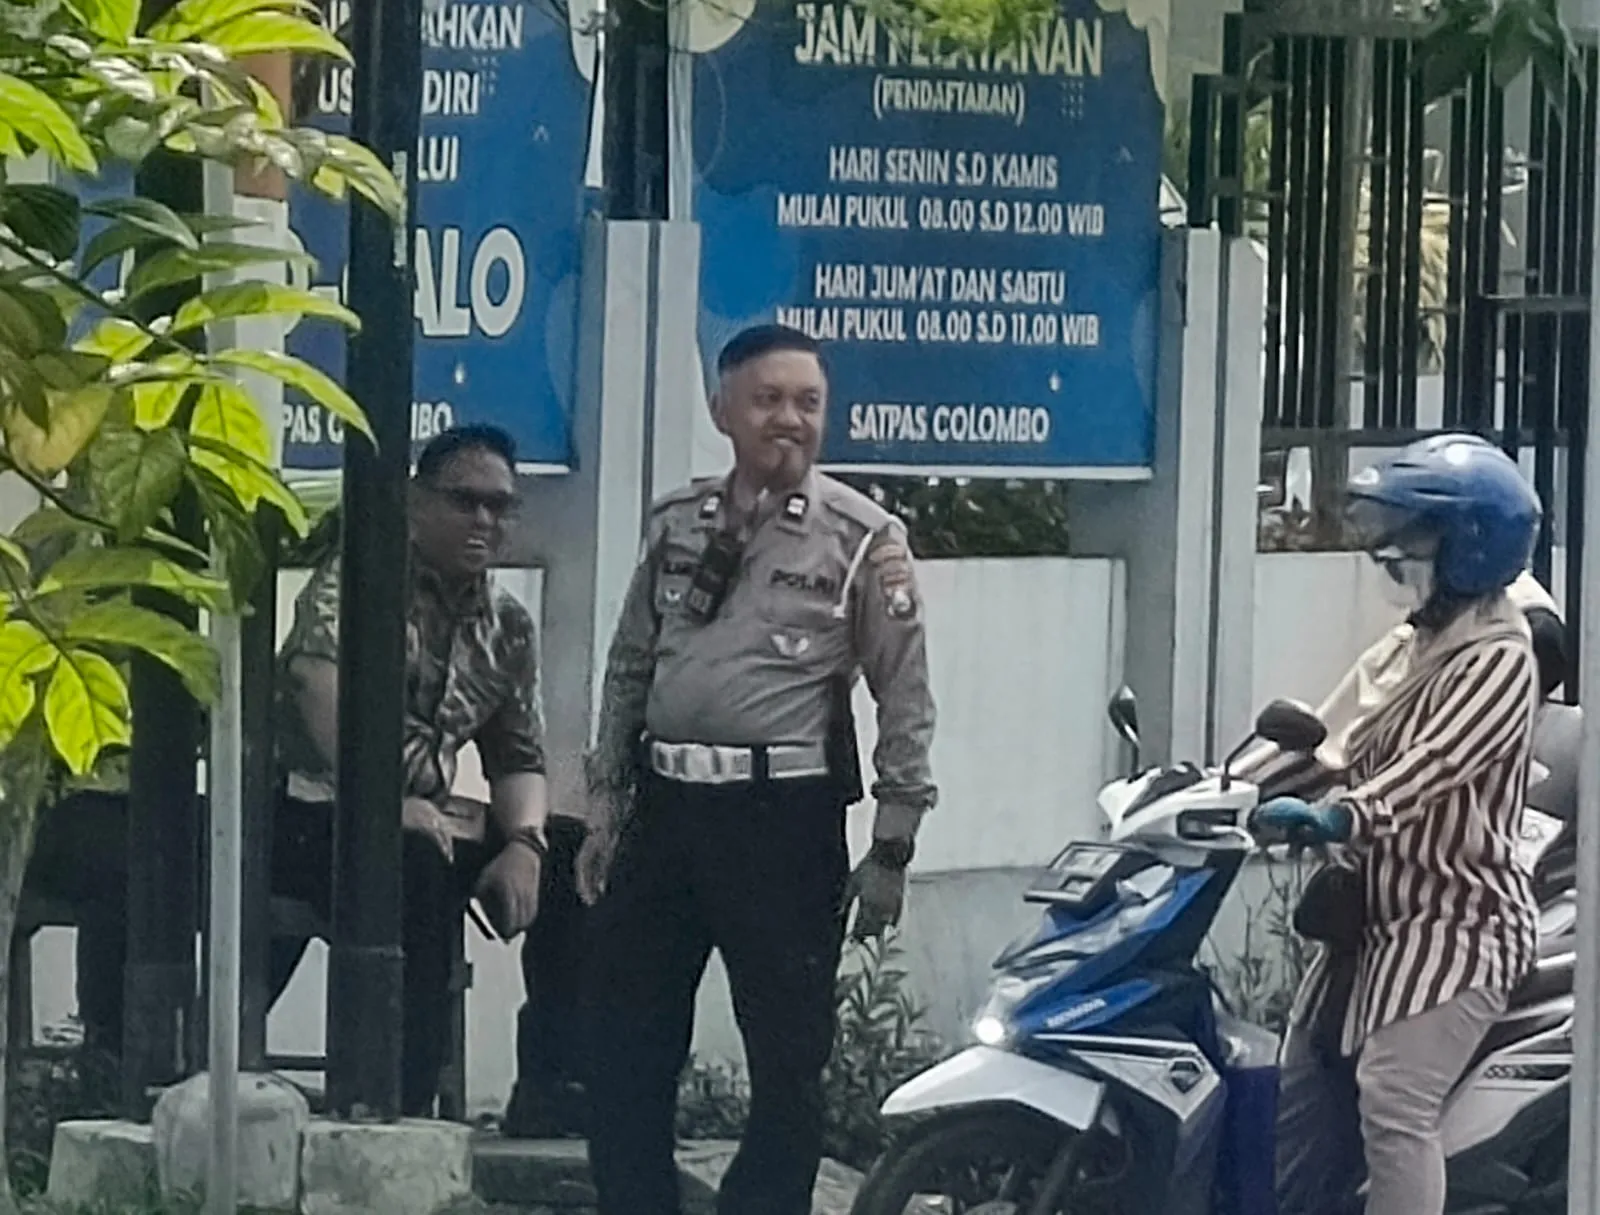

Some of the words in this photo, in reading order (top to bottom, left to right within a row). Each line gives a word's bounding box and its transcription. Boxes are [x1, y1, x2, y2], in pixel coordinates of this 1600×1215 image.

[795, 3, 876, 65] JAM
[873, 74, 1025, 126] (PENDAFTARAN)
[829, 146, 880, 183] HARI
[885, 148, 949, 186] SENIN
[955, 151, 987, 186] S.D
[992, 153, 1058, 189] KAMIS
[778, 192, 841, 227] MULAI
[845, 194, 909, 230] PUKUL
[919, 197, 975, 231] 08.00
[979, 200, 1009, 232] S.D
[1014, 202, 1063, 235] 12.00
[814, 262, 865, 299] HARI
[870, 264, 946, 302] JUM'AT
[951, 267, 996, 303] DAN
[1001, 269, 1066, 305] SABTU
[776, 305, 839, 340] MULAI
[843, 307, 907, 341] PUKUL
[916, 309, 972, 342] 08.00
[976, 311, 1006, 343] S.D
[1011, 312, 1058, 345] 11.00
[1061, 313, 1099, 346] WIB
[849, 403, 928, 441] SATPAS
[932, 405, 1050, 443] COLOMBO
